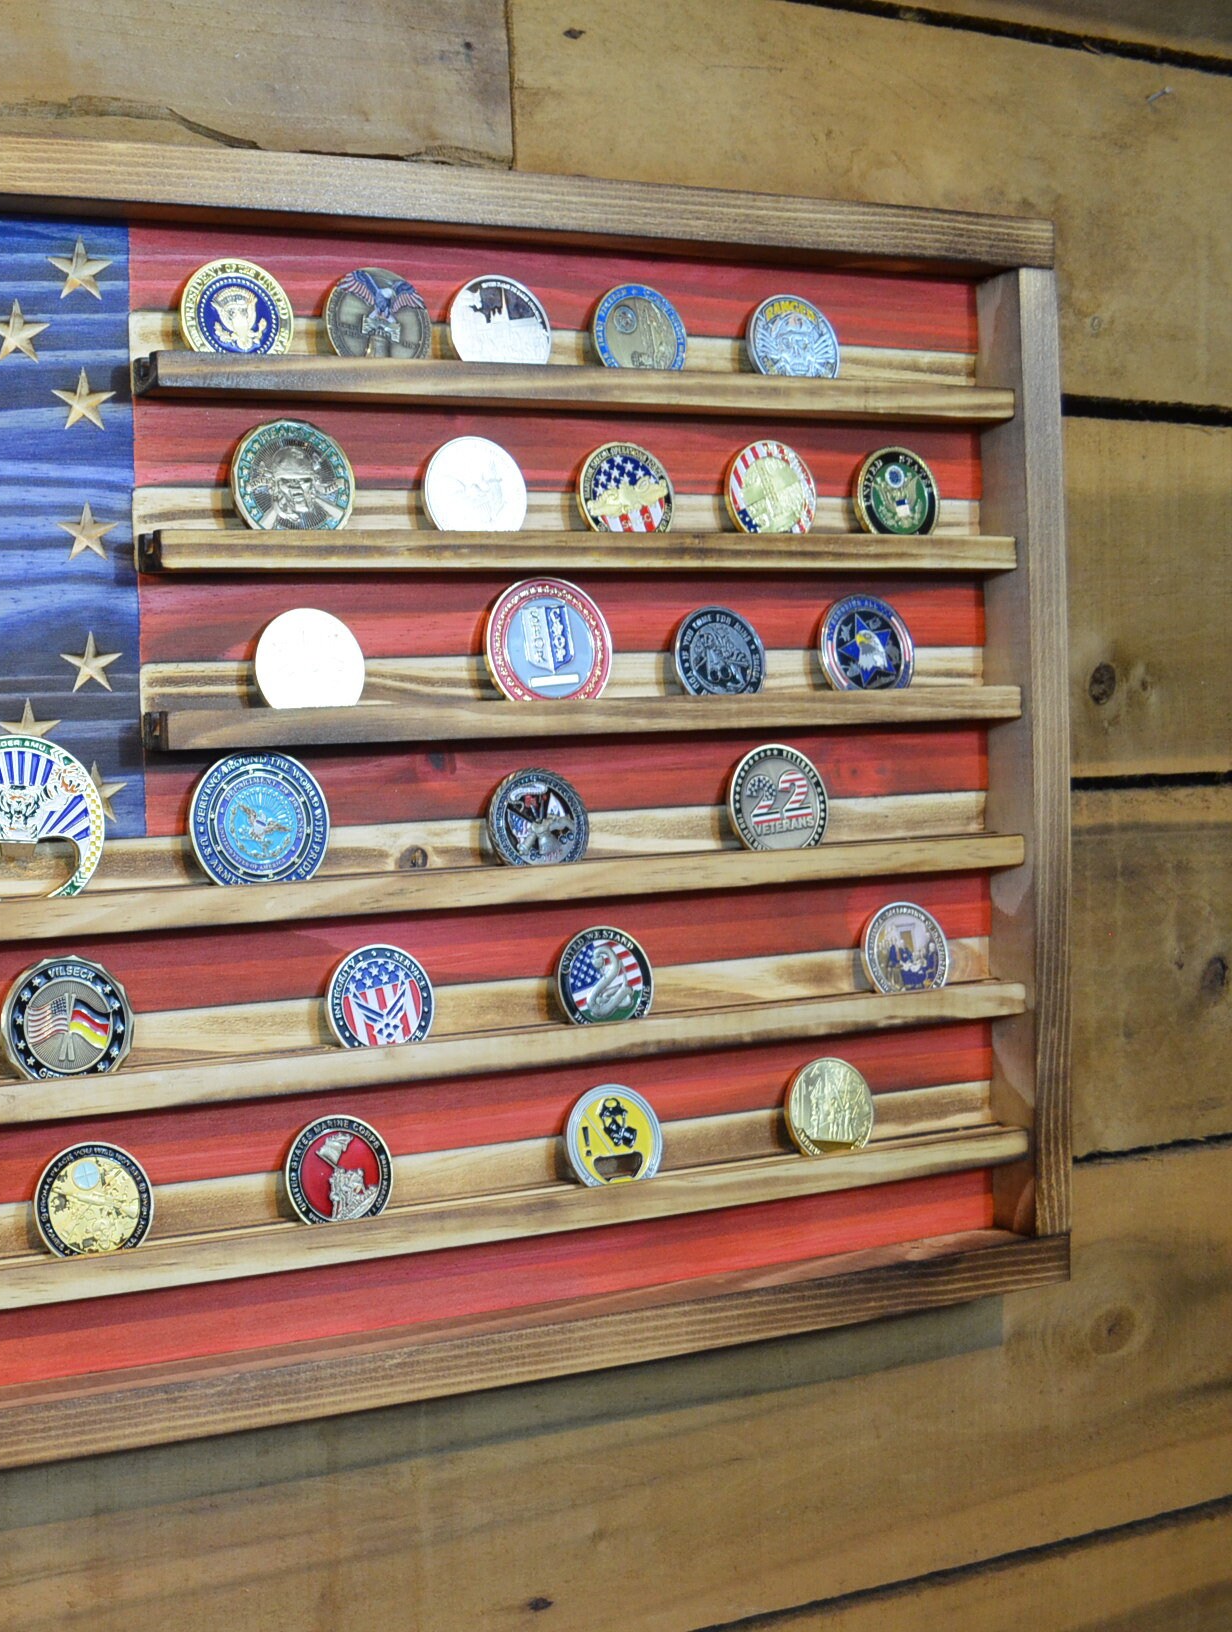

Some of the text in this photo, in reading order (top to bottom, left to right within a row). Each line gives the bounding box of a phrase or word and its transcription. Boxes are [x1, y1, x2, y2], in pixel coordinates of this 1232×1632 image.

[186, 265, 223, 321] PRESIDENT
[765, 300, 817, 323] RANGER
[863, 460, 883, 505] UNITED
[683, 629, 694, 646] YOU
[692, 614, 713, 628] COME
[716, 614, 732, 624] FOR
[24, 740, 47, 751] AMU
[782, 751, 817, 782] VETERANS
[225, 776, 277, 801] DEPARTMENT
[746, 769, 813, 824] 22
[197, 756, 324, 877] SERVING AROUND THE WORLD WITH PRIDE
[754, 816, 815, 836] VETERANS
[200, 836, 246, 885] U.S. ARMED
[562, 931, 634, 974] UNITED WE STAND
[48, 966, 96, 981] VILSECK
[393, 953, 426, 988] SERVICE
[333, 959, 355, 1019] INTEGRITY
[50, 1154, 74, 1177] PLACE
[74, 1147, 93, 1157] YOU
[94, 1147, 114, 1157] WILL
[291, 1120, 380, 1212] UNITED STATES MARINE CORPS
